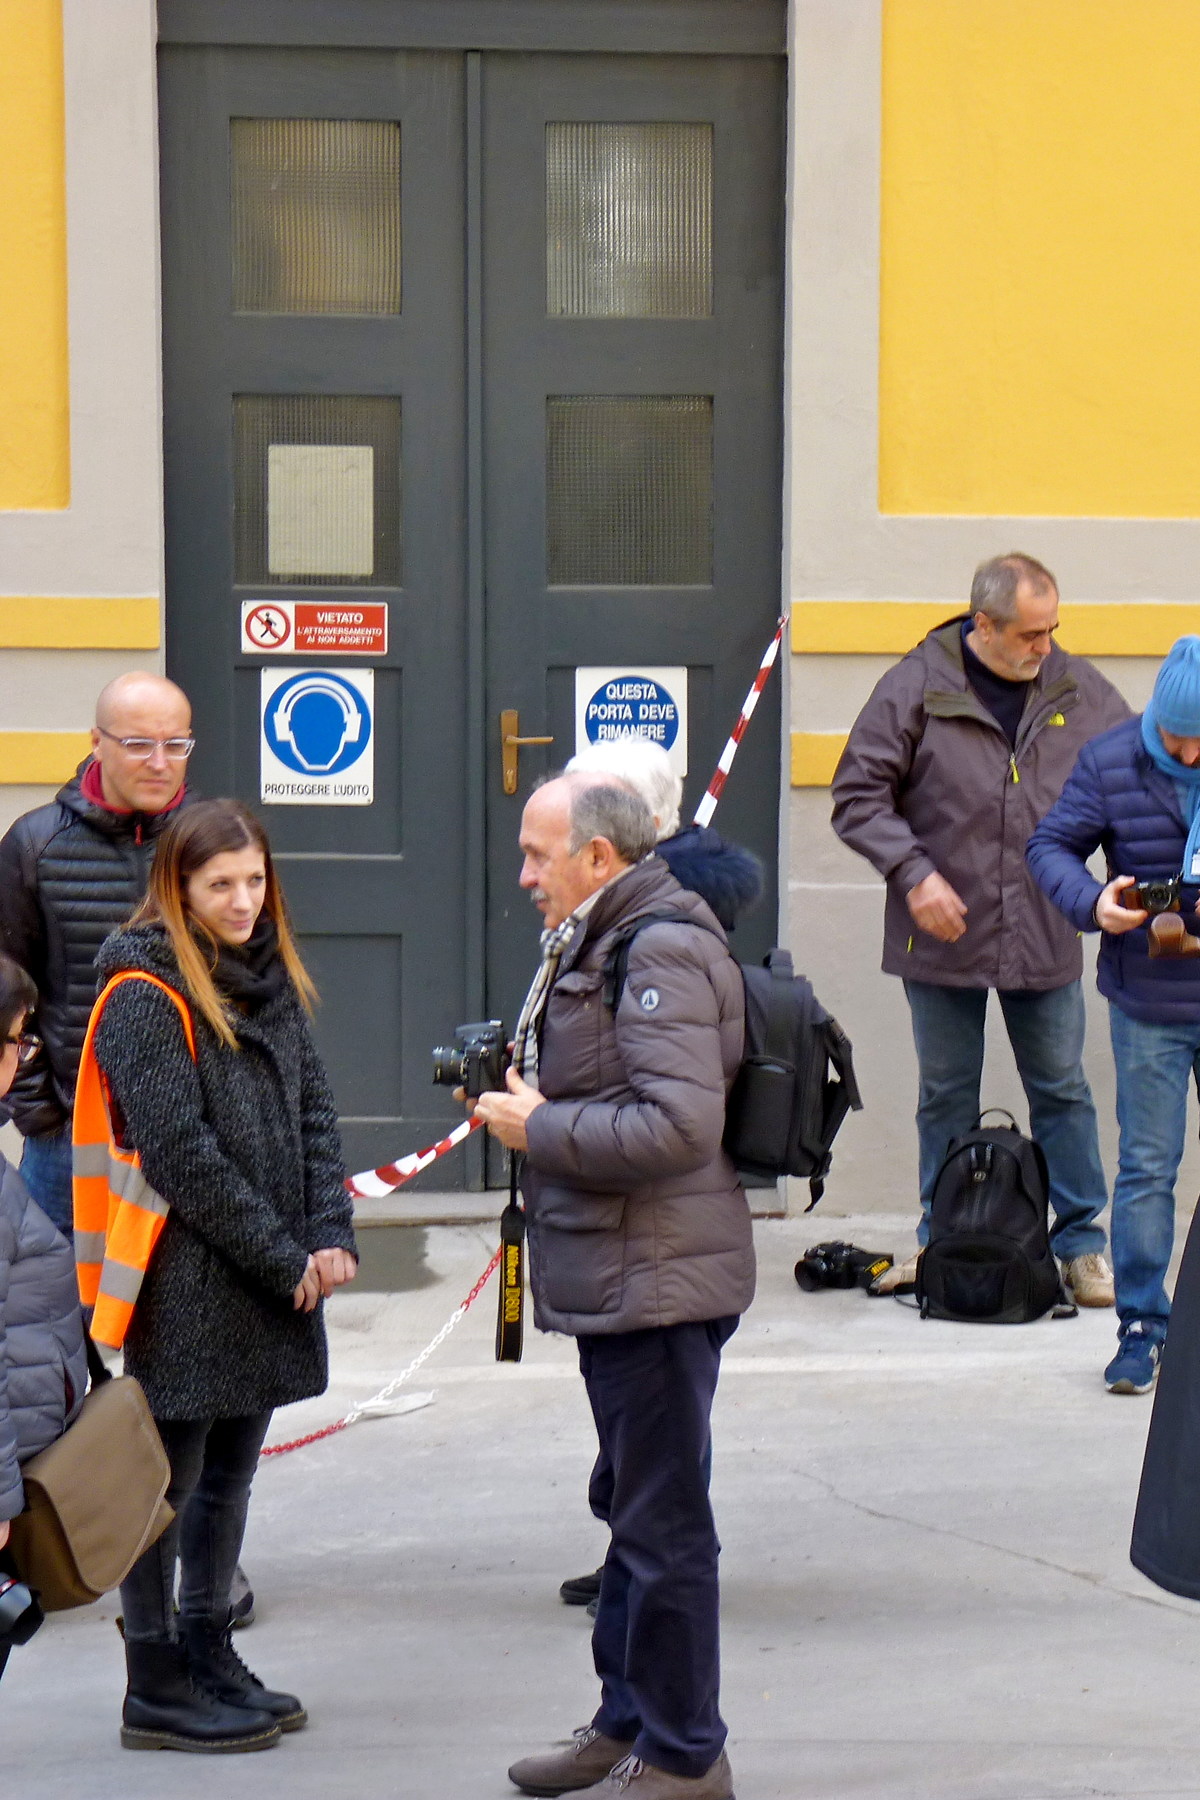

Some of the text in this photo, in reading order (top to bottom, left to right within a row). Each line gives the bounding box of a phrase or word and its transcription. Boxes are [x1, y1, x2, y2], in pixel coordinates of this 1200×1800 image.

[316, 612, 364, 624] VIETATO
[297, 626, 383, 637] L'ATTRAVERSAMENTO
[307, 635, 374, 645] AI NON ADDETTI
[606, 683, 657, 700] QUESTA
[589, 704, 675, 720] PORTA DEVE
[598, 724, 666, 741] RIMANERE
[265, 784, 370, 796] PROTEGGERE L'UDITO
[505, 1244, 520, 1323] Nikon D800
